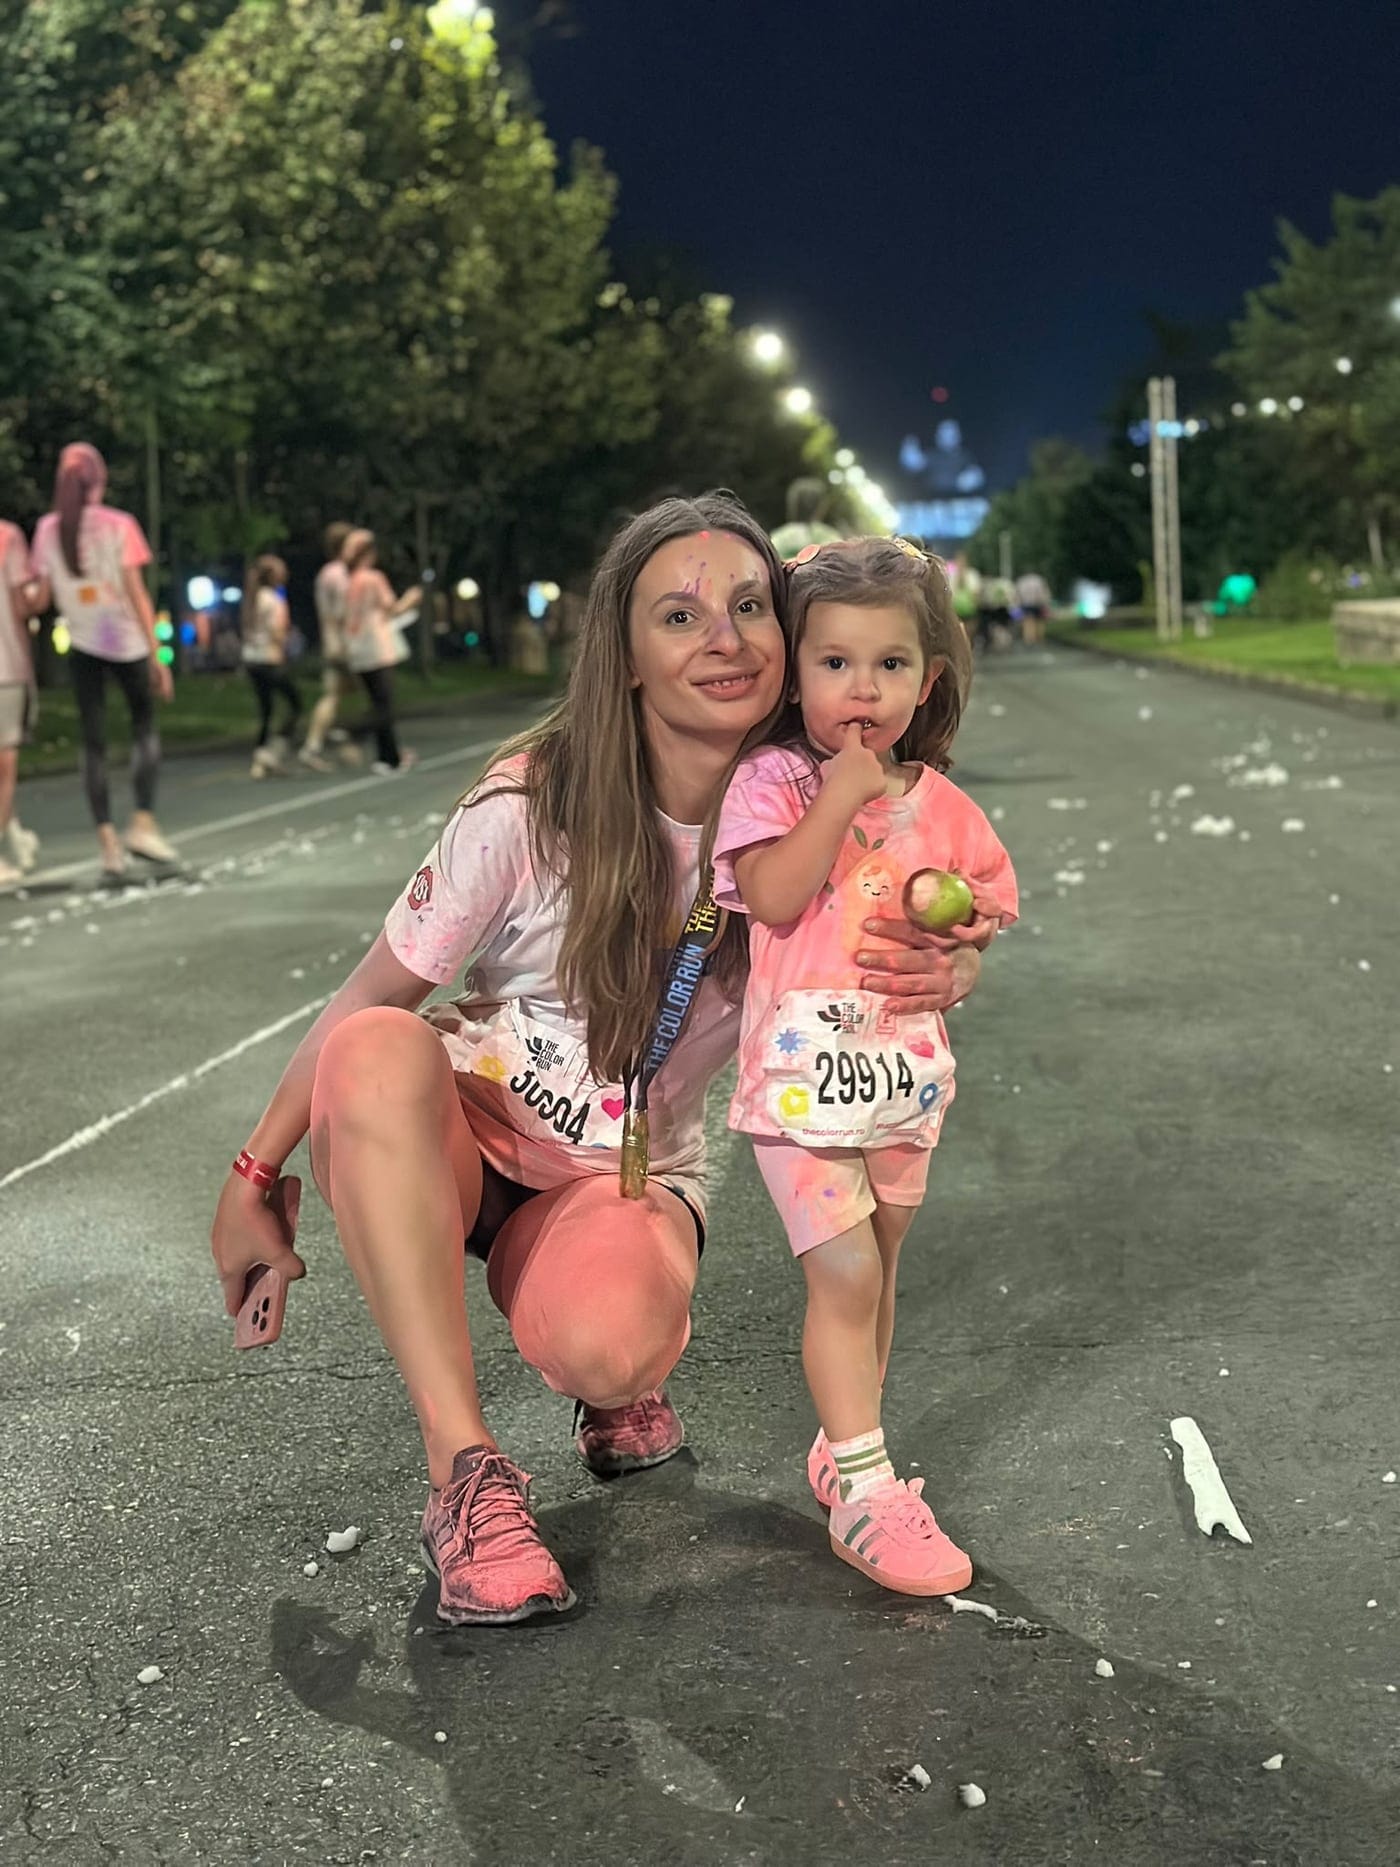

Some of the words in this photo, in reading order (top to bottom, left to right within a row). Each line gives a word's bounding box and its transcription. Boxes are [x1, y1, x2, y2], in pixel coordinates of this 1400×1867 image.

[676, 943, 706, 982] RUN
[656, 980, 695, 1040] COLOR
[841, 1002, 857, 1013] THE
[539, 1049, 565, 1067] COLOR
[544, 1040, 560, 1054] THE
[647, 1038, 672, 1069] THE
[815, 1051, 915, 1105] 29914
